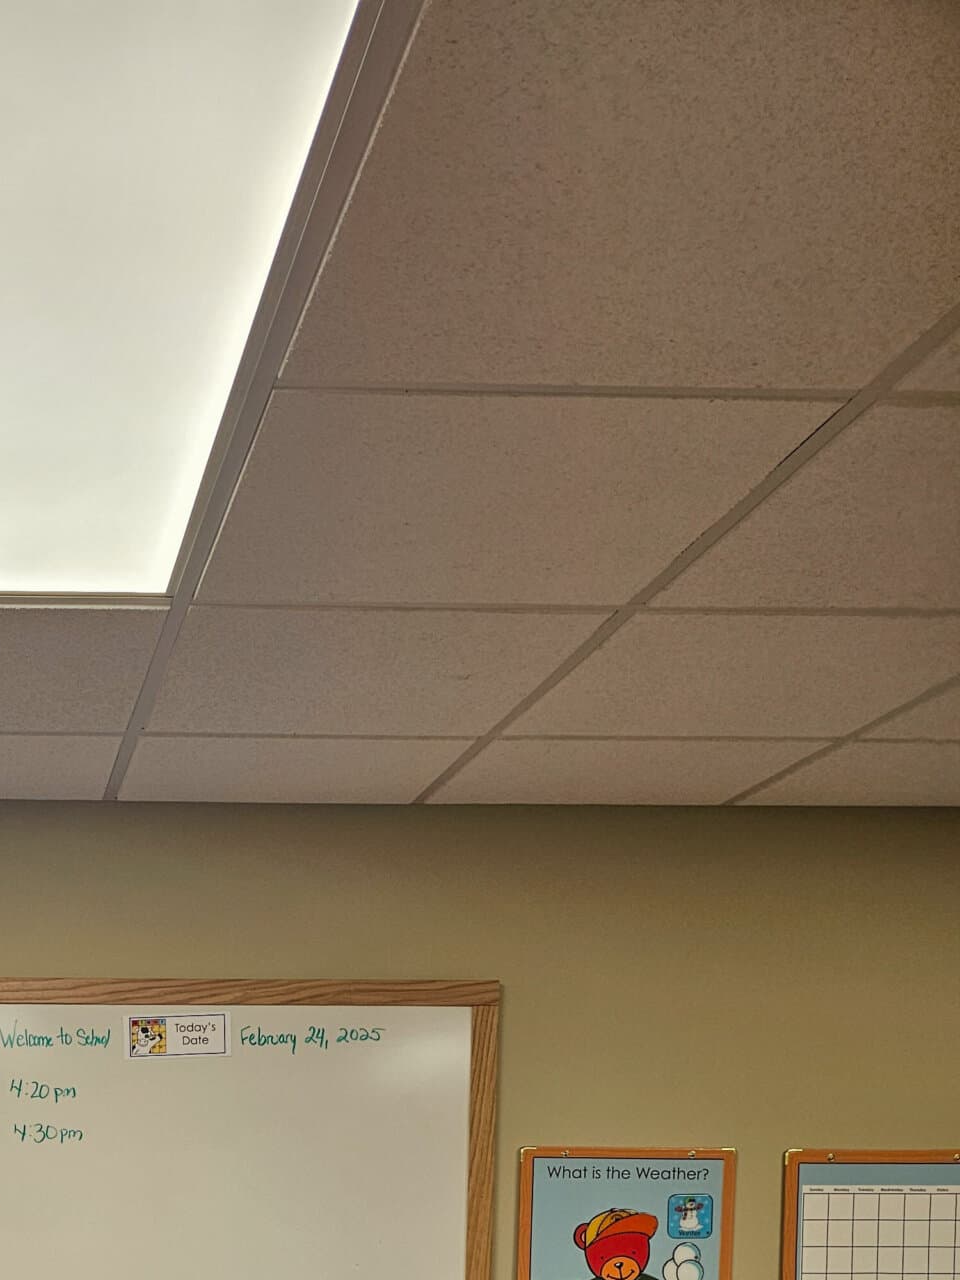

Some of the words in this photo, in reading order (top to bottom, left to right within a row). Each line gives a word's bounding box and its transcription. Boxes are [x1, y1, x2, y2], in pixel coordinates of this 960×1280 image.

[174, 1021, 217, 1034] Today's
[57, 1027, 72, 1045] to
[182, 1035, 209, 1046] Date
[240, 1026, 297, 1055] February
[304, 1026, 328, 1049] 24,
[336, 1027, 385, 1043] 2025
[9, 1079, 49, 1098] 4:20
[547, 1166, 588, 1179] What
[592, 1166, 601, 1179] is
[606, 1166, 631, 1180] the
[636, 1167, 709, 1180] Weather?
